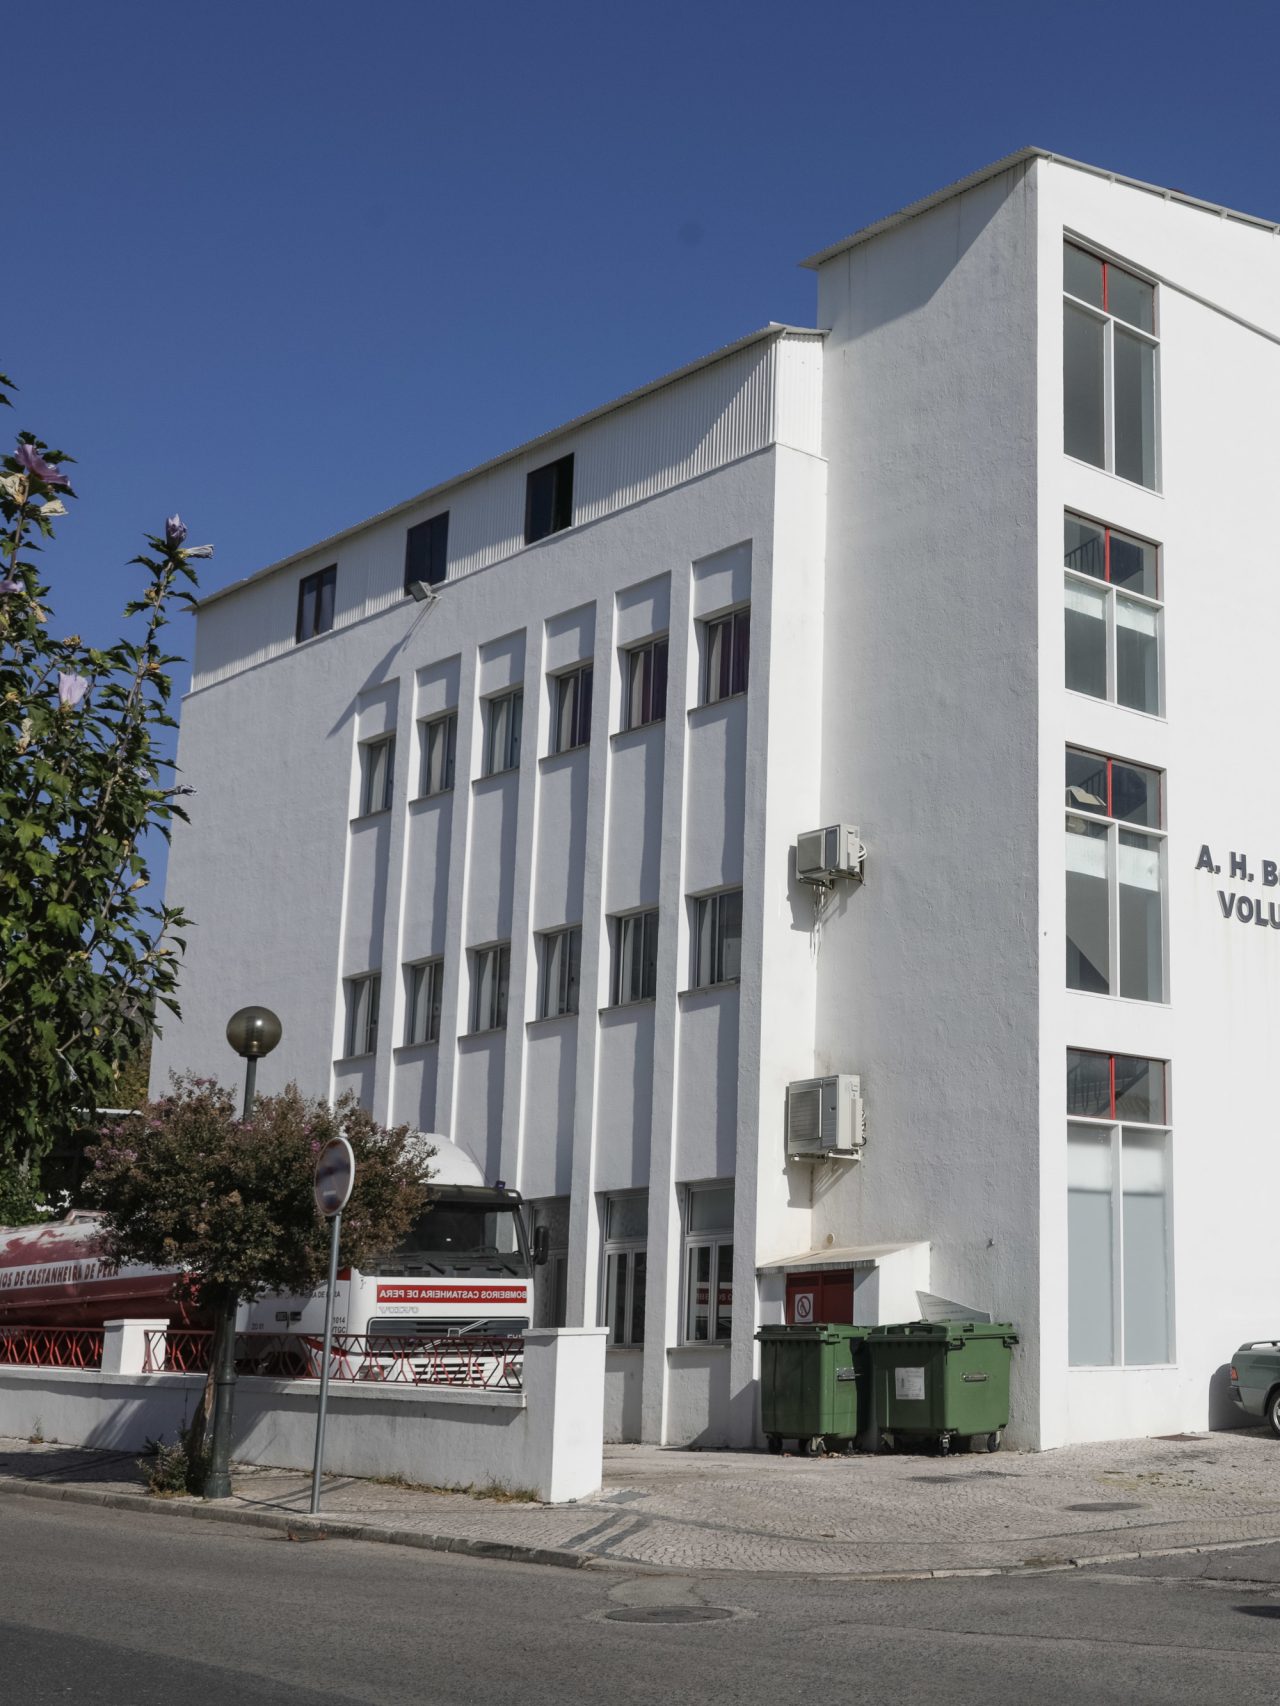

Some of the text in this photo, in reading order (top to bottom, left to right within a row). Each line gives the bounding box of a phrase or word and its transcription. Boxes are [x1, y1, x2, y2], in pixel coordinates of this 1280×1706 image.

[1194, 844, 1221, 875] A.
[1229, 851, 1255, 883] H.
[14, 1270, 25, 1287] DE
[26, 1264, 83, 1286] CASTANHEIRA
[84, 1263, 97, 1281] DE
